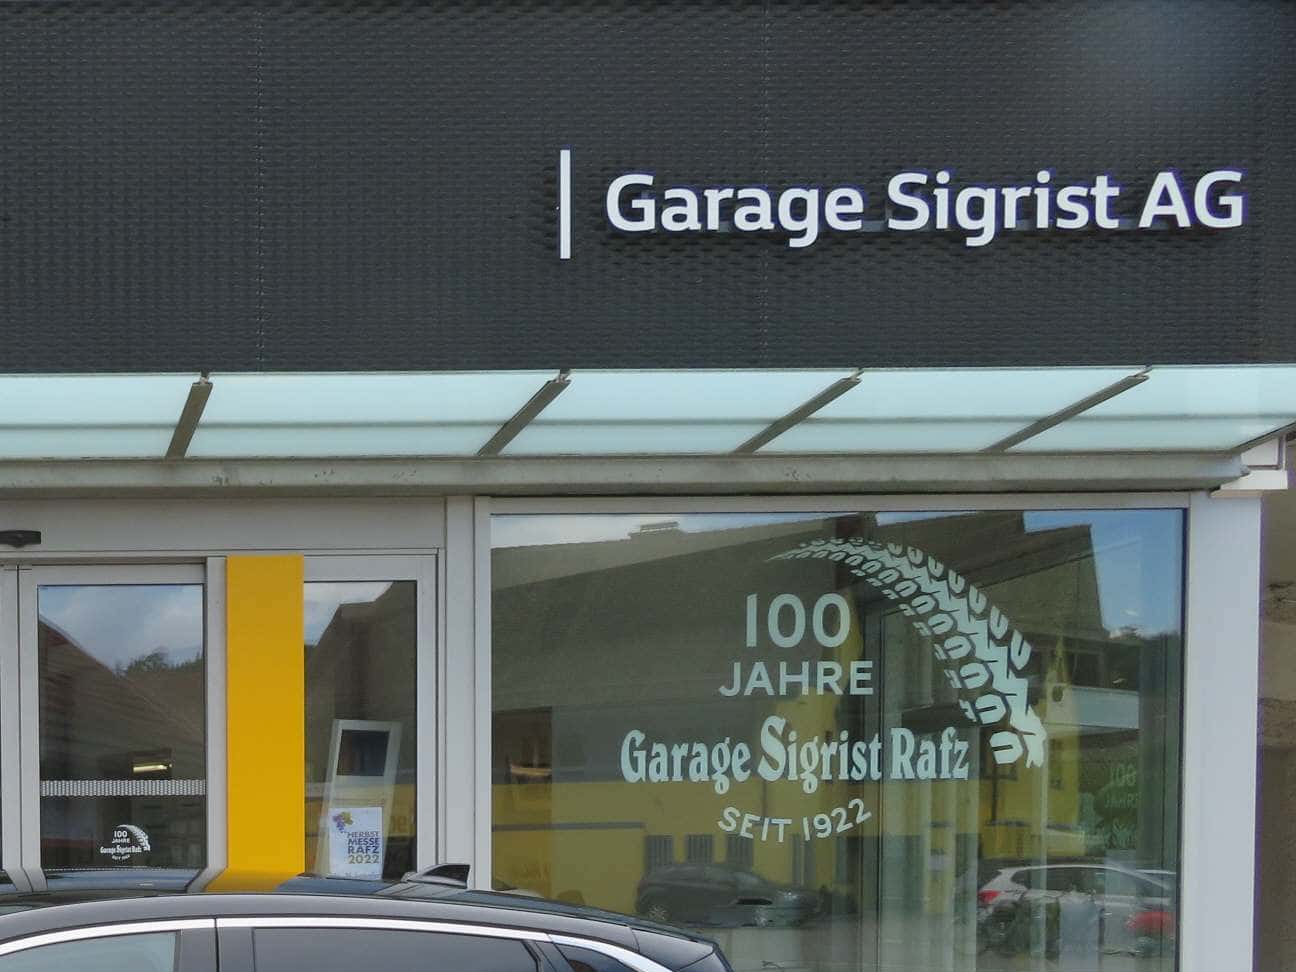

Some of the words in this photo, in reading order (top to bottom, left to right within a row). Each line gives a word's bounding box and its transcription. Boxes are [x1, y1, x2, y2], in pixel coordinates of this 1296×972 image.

[605, 173, 864, 248] Garage
[887, 171, 1120, 247] Sigrist
[1137, 170, 1245, 228] AG
[745, 593, 852, 648] 100
[718, 660, 874, 697] JAHRE
[620, 729, 751, 794] Garage
[757, 715, 882, 793] Sigrist
[890, 726, 969, 781] Rafz
[114, 830, 128, 838] 100
[717, 805, 793, 843] SEIT
[802, 798, 872, 841] 1922
[347, 837, 380, 846] MESSE
[347, 846, 380, 854] RAFZ
[347, 854, 380, 864] 2022
